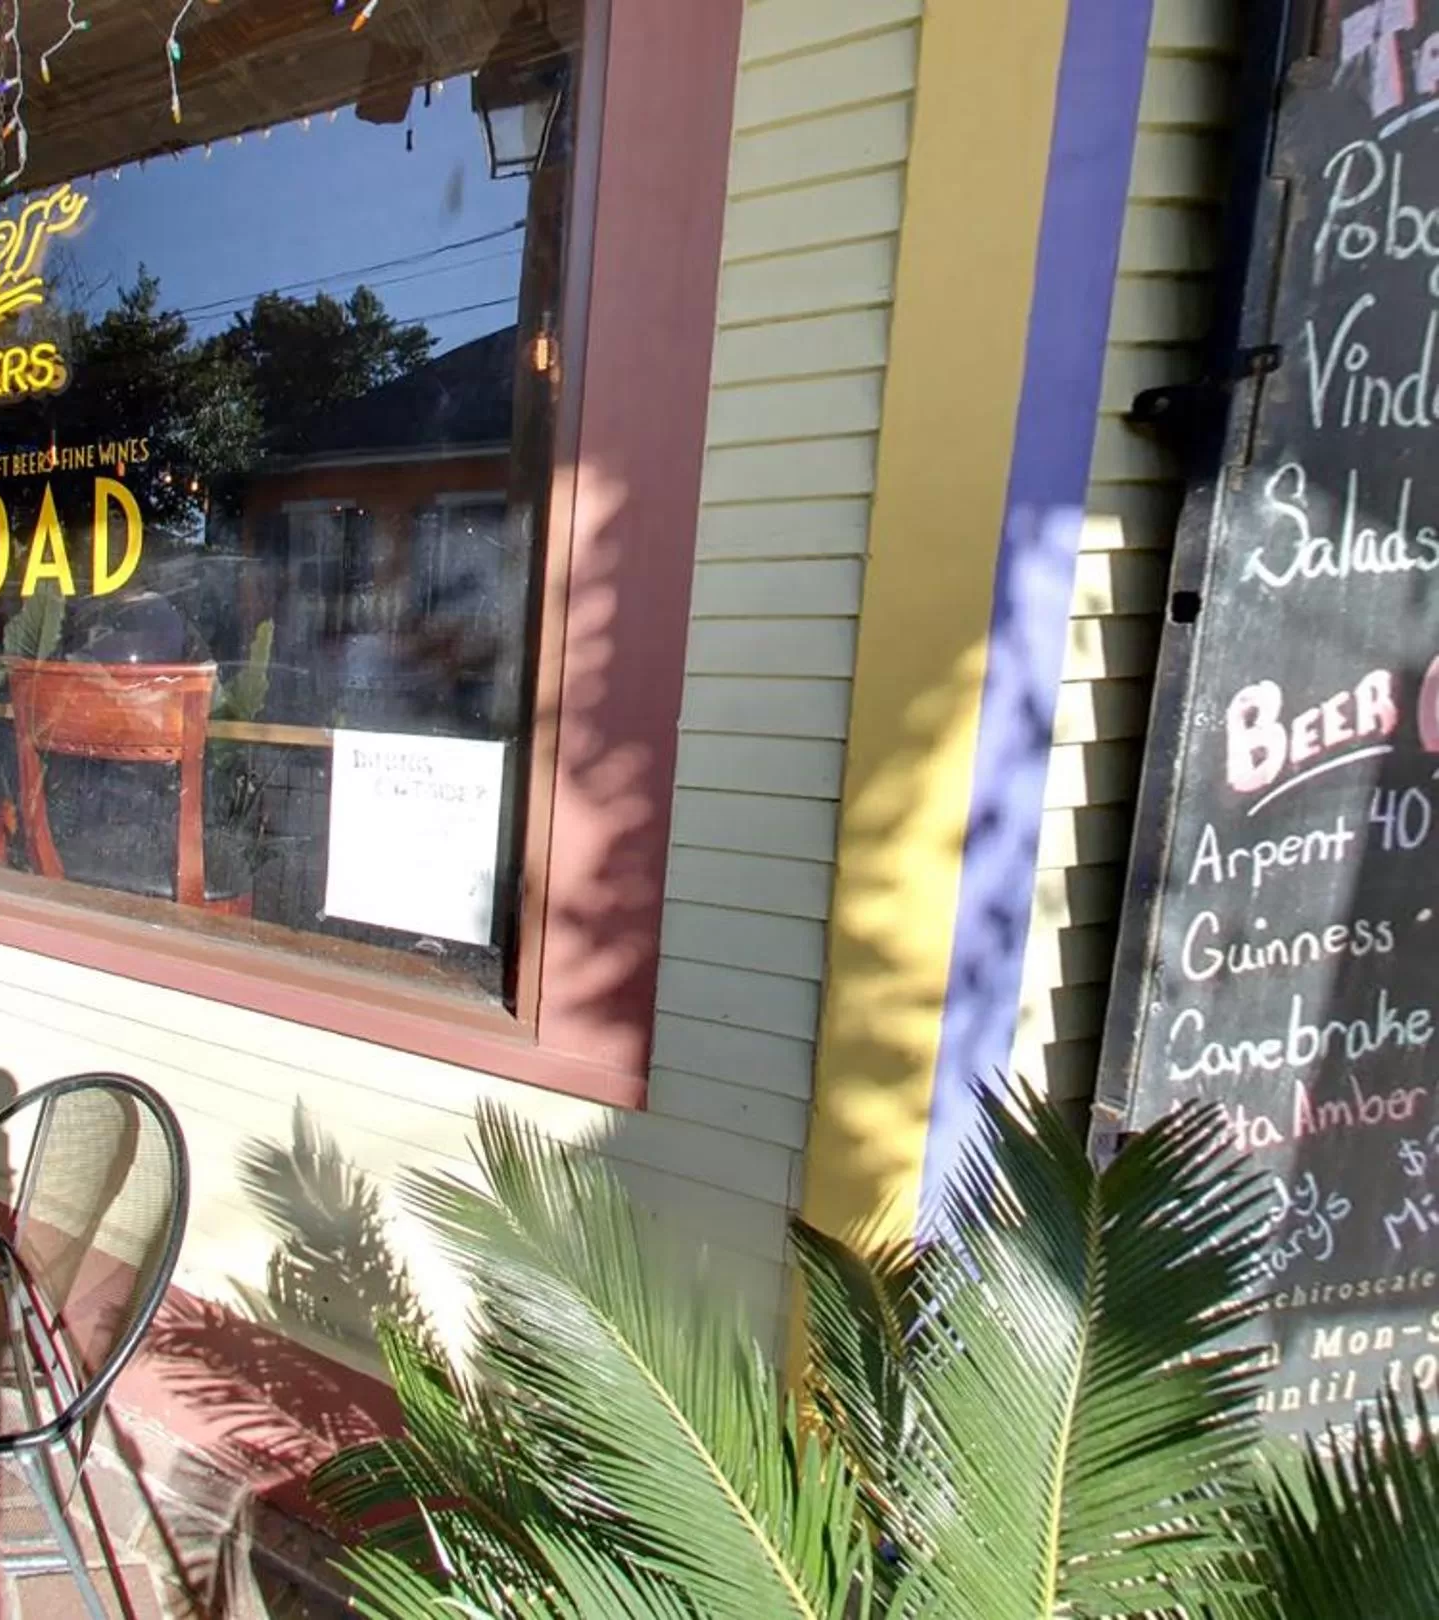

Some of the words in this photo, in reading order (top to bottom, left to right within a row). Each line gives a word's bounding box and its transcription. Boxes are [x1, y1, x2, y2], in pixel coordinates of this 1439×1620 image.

[98, 437, 150, 467] WINES
[1241, 463, 1439, 588] Salads
[1227, 669, 1396, 793] BEER
[1189, 816, 1354, 888] Arpent
[1182, 911, 1394, 981] Guinness
[1169, 989, 1434, 1081] Canebrake
[1292, 1076, 1429, 1139] Amber
